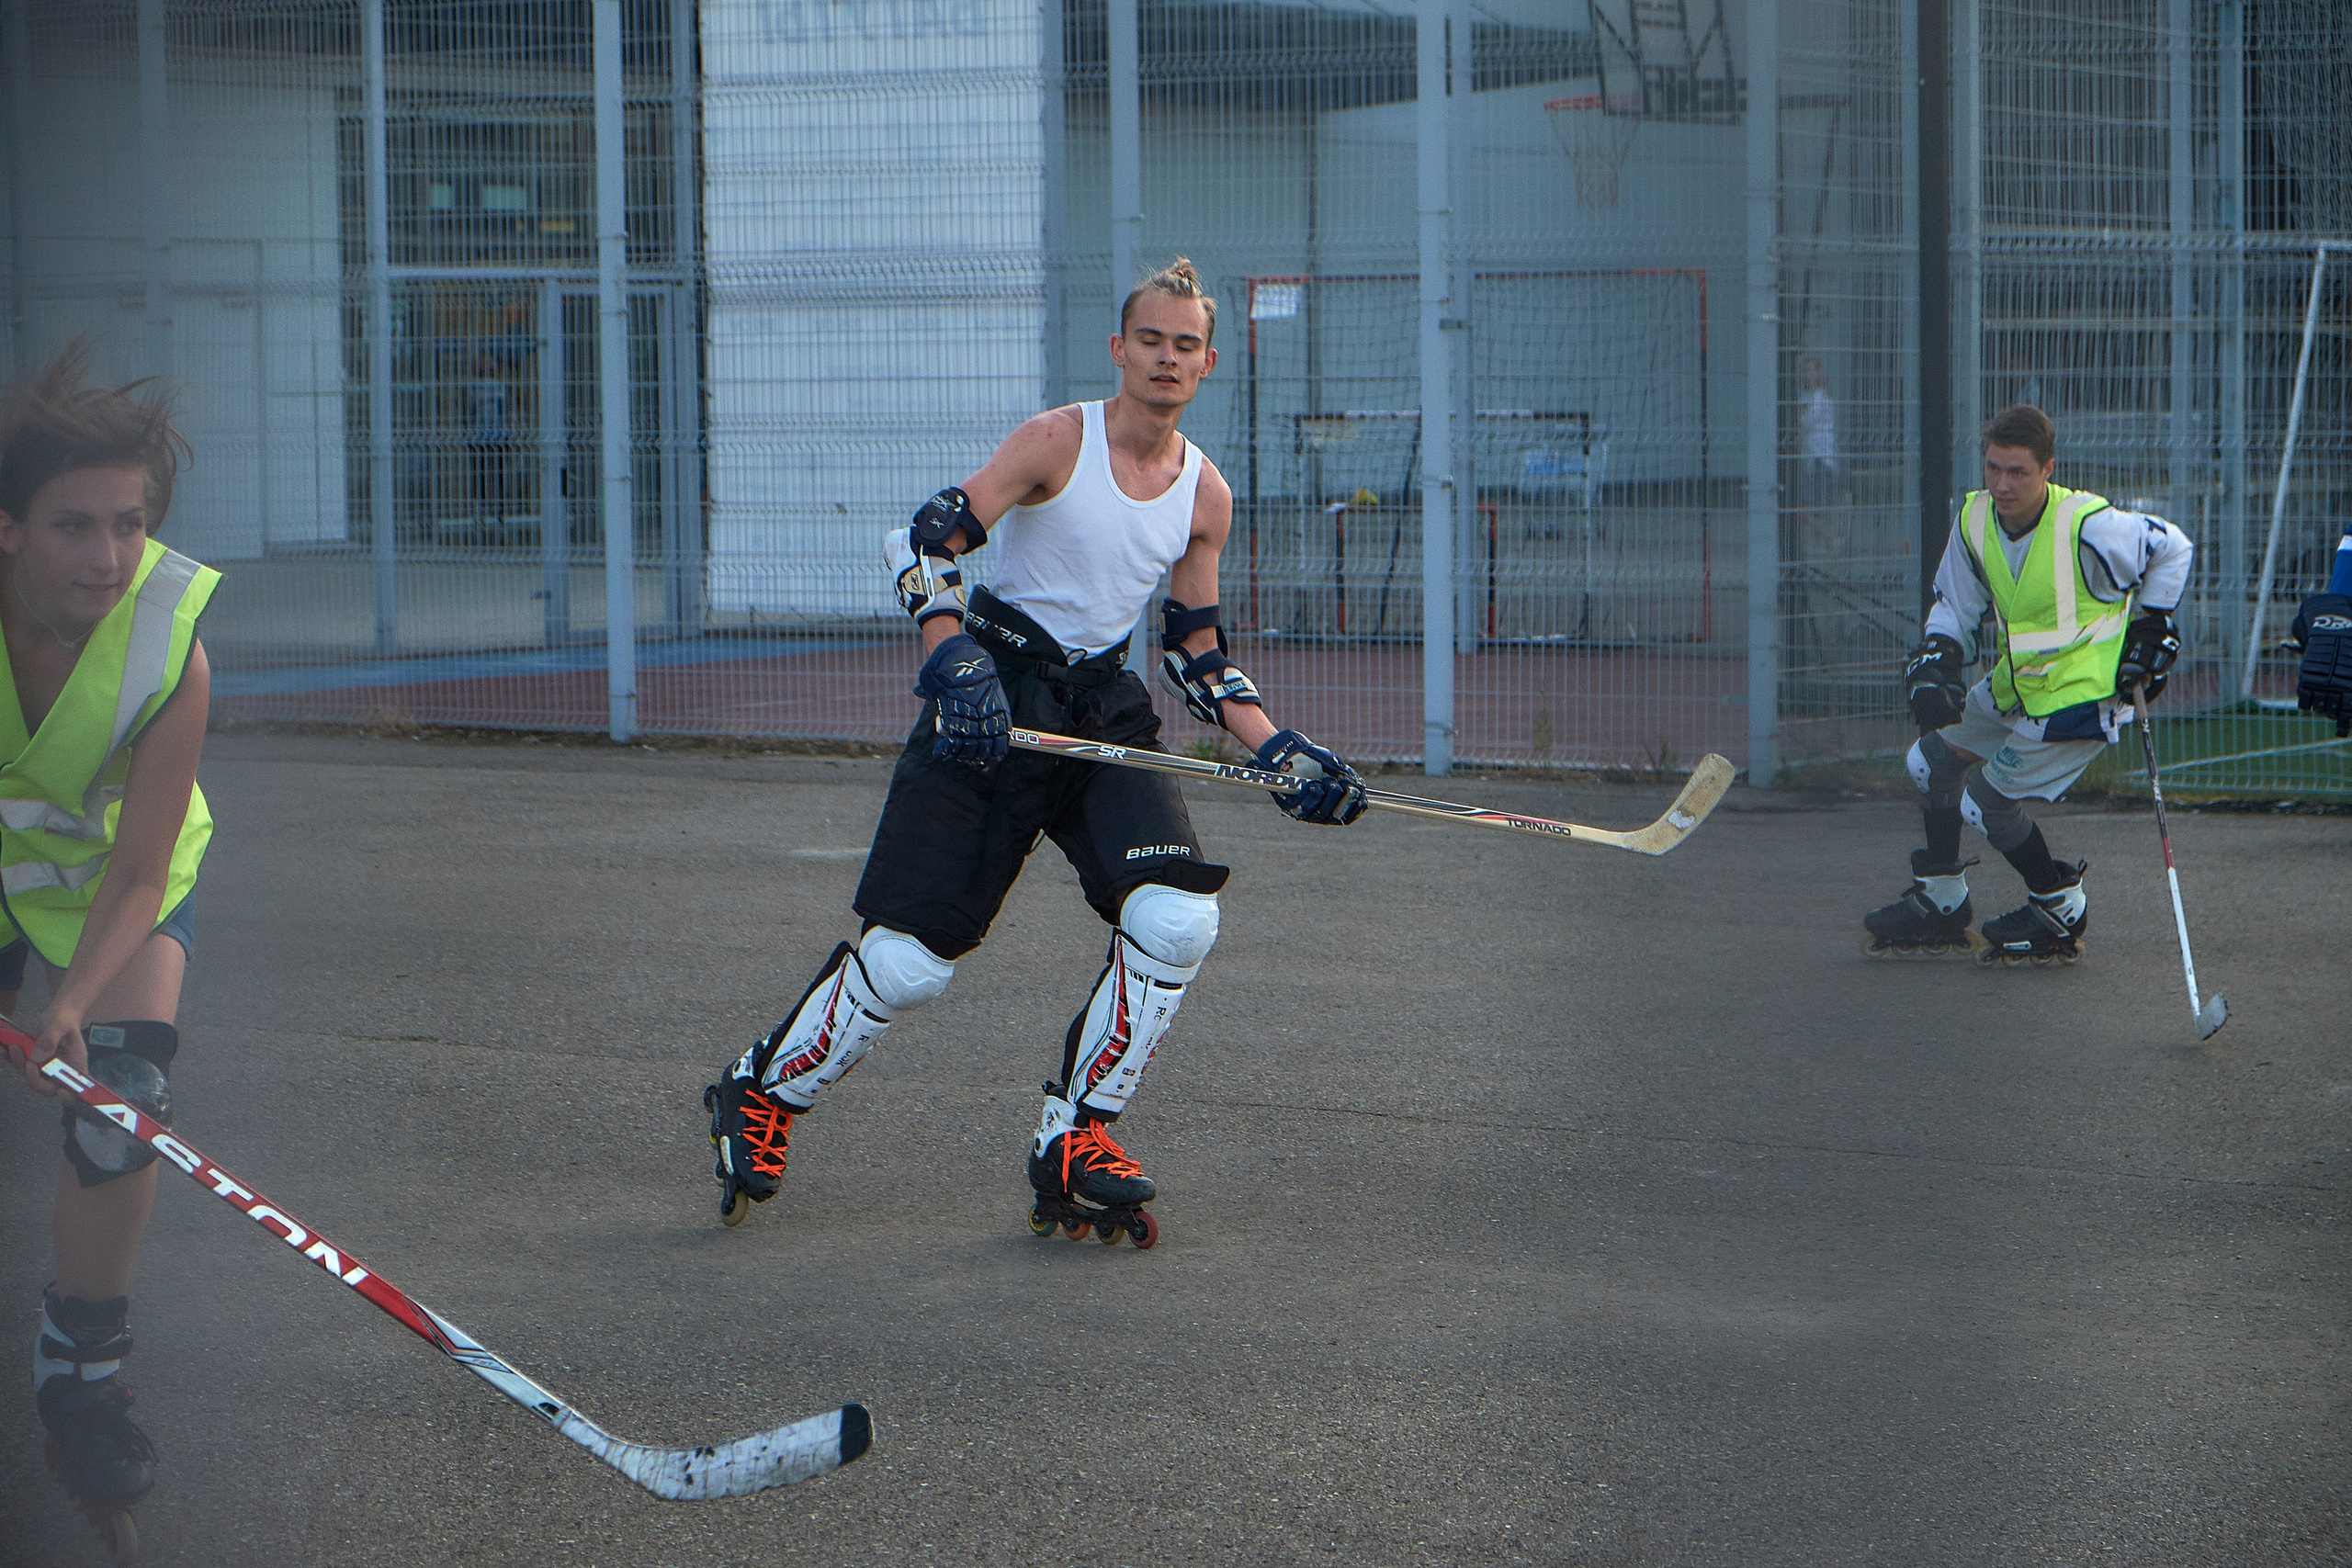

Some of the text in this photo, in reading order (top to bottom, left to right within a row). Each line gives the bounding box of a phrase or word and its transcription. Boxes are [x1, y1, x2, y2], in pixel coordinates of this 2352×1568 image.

[1905, 651, 1943, 679] CM
[1097, 745, 1127, 760] SR
[1505, 817, 1572, 836] TORNADO
[40, 1056, 368, 1286] EASTON
